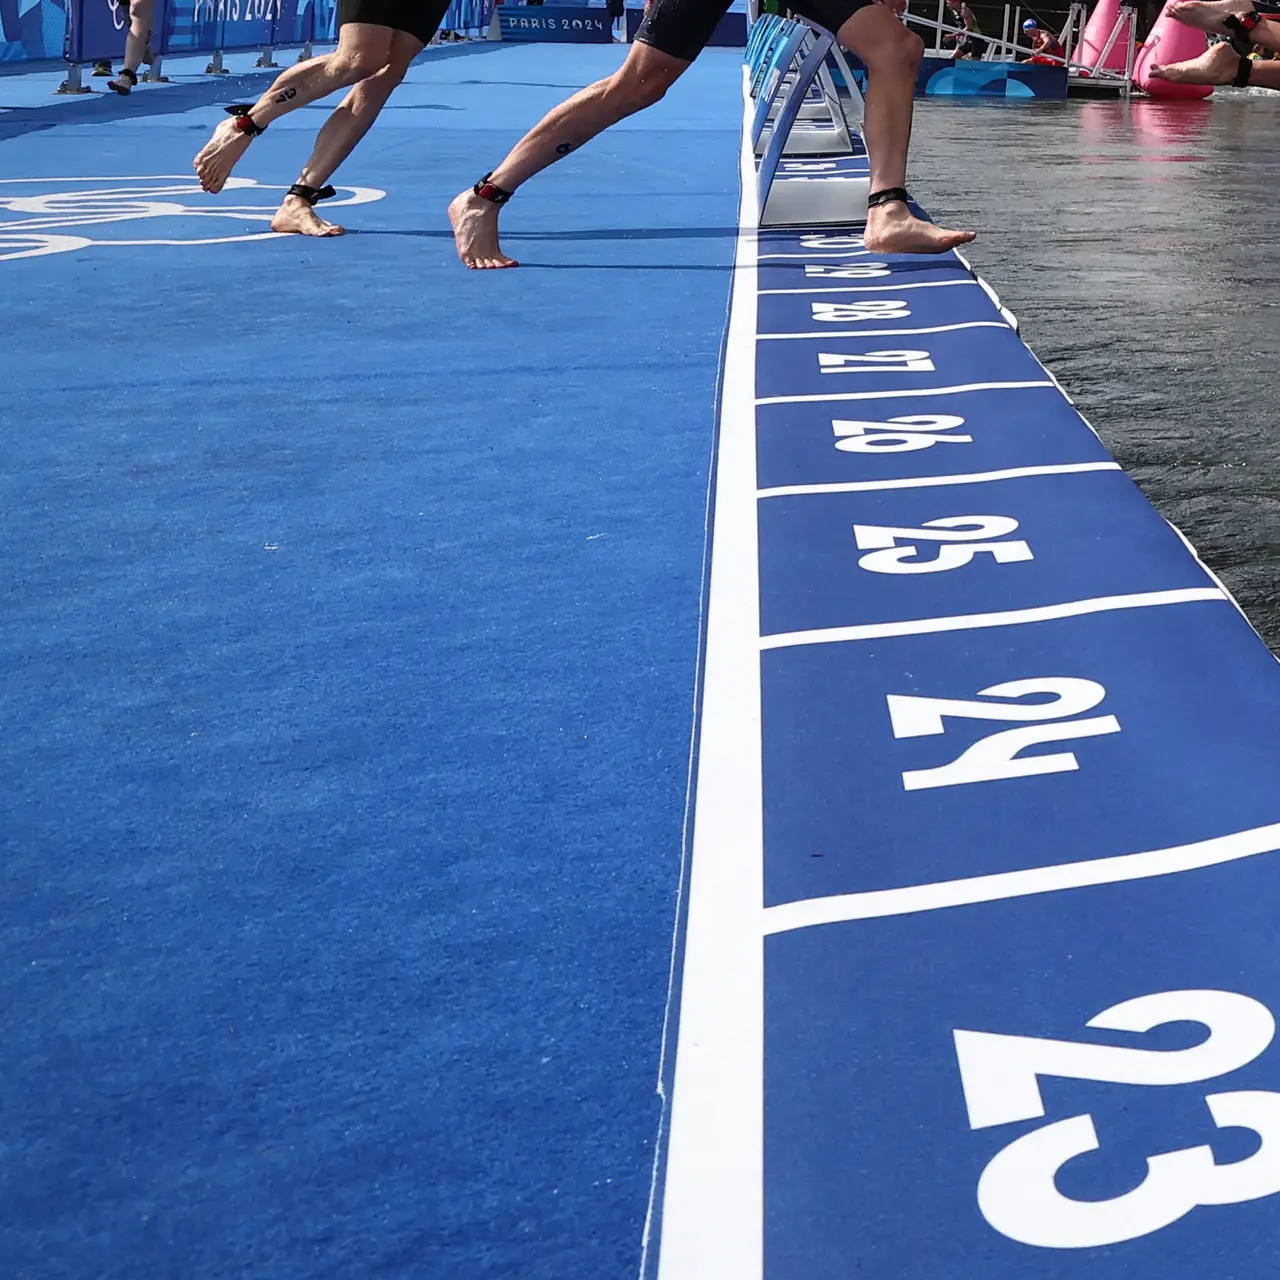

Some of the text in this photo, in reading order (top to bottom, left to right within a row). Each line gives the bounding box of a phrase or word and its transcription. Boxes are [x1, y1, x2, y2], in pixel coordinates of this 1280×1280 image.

[509, 17, 603, 30] PARIS 2024
[805, 262, 892, 279] 29
[811, 300, 912, 321] 28
[818, 350, 936, 373] 27
[831, 414, 973, 454] 26
[853, 515, 1035, 574] 25
[887, 677, 1122, 791] 24
